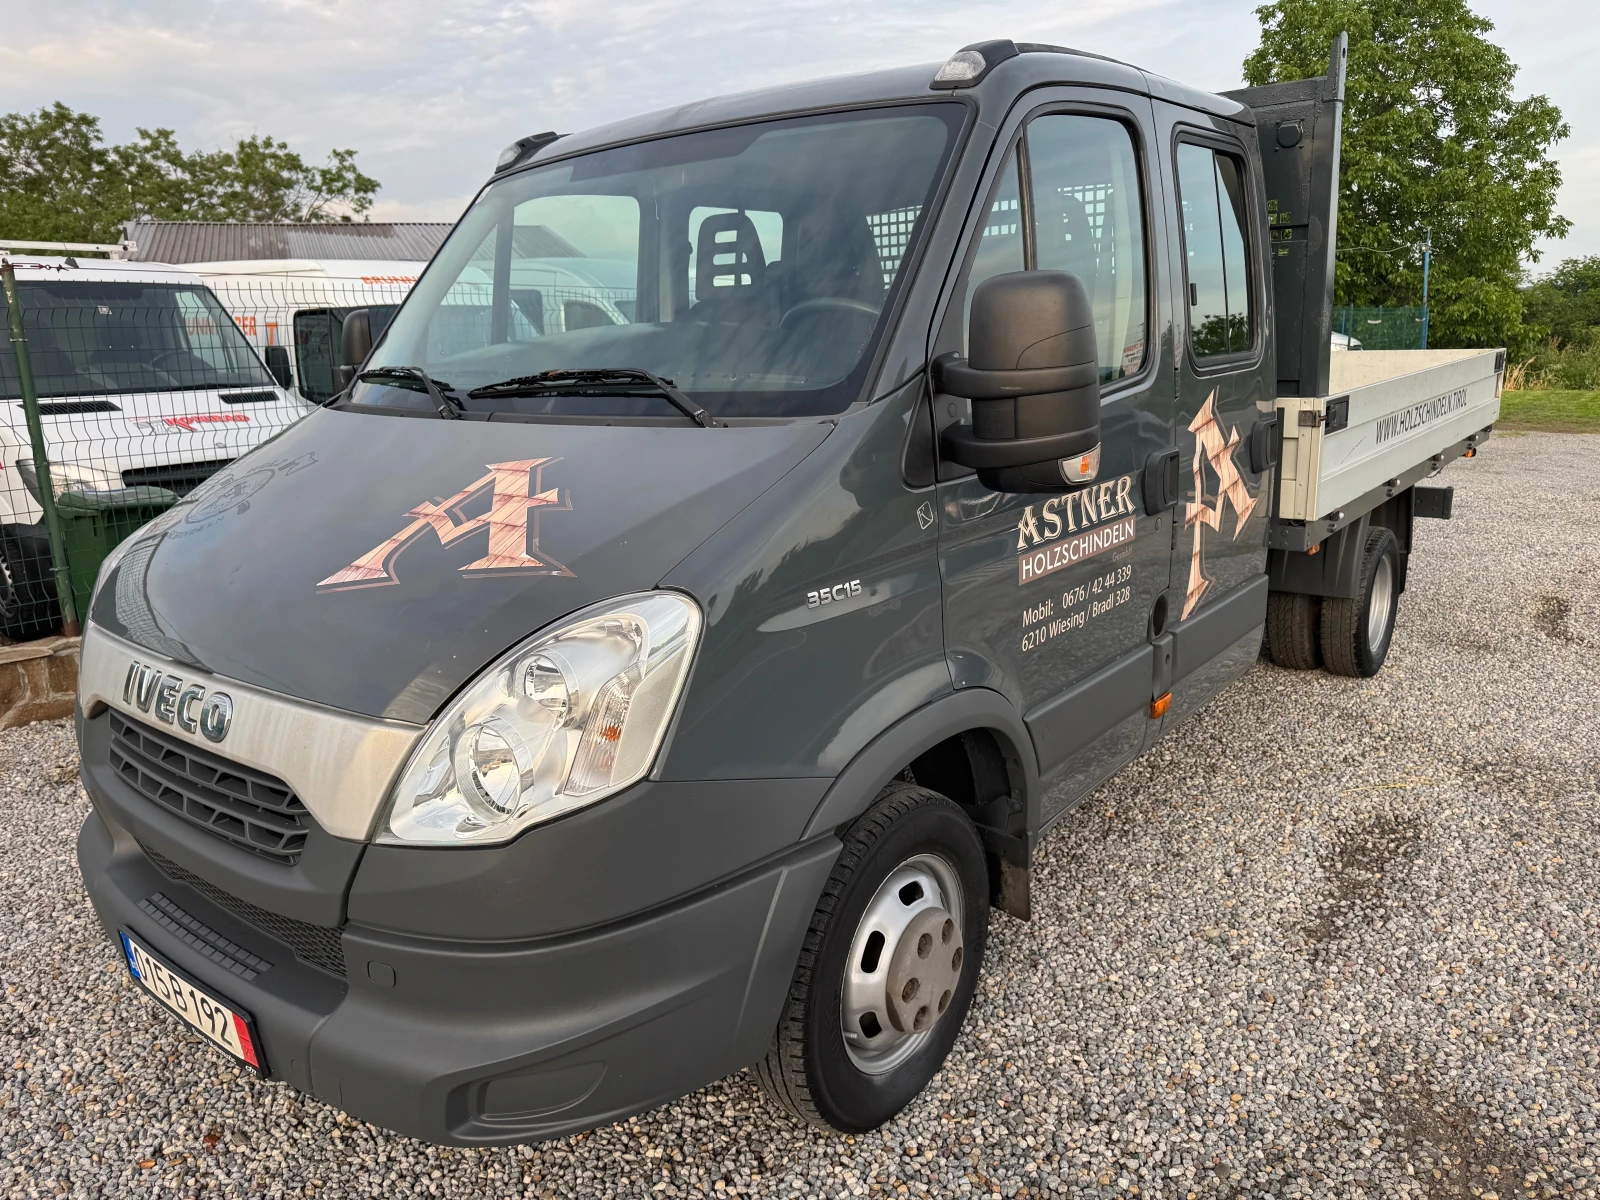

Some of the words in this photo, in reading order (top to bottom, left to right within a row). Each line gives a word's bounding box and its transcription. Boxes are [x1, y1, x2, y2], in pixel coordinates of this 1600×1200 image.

[1016, 475, 1136, 551] ASTNER
[1021, 519, 1135, 580] HOLZSCHINDELN
[807, 579, 862, 609] 35C15
[1021, 626, 1047, 652] 6210
[1049, 611, 1085, 639] Wiesing
[1092, 592, 1114, 618] Bradl
[1115, 586, 1131, 606] 328
[1022, 599, 1054, 627] Mobil:
[1062, 585, 1085, 609] 0676
[1092, 577, 1103, 594] 42
[1104, 571, 1115, 589] 44
[1116, 564, 1132, 585] 339
[122, 660, 234, 743] IVECO
